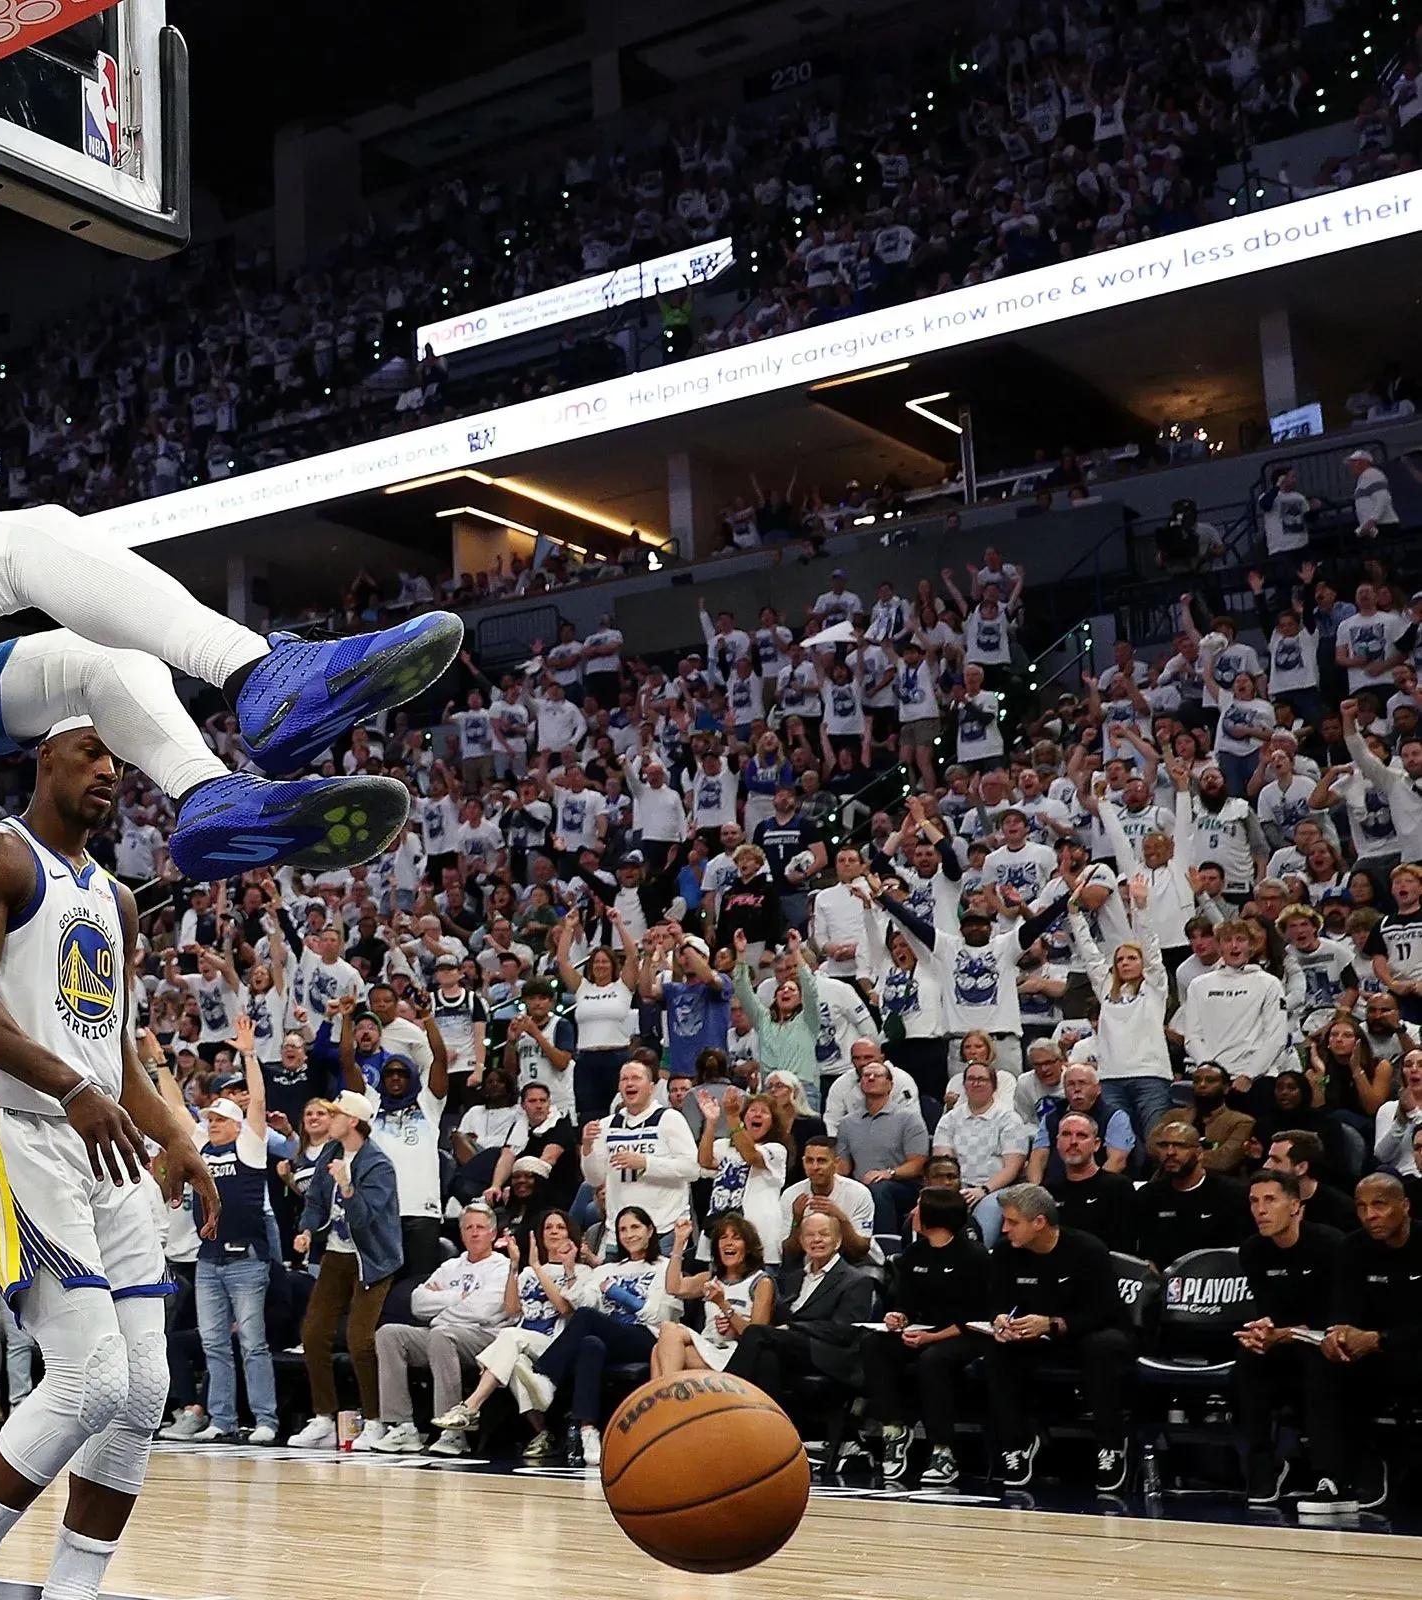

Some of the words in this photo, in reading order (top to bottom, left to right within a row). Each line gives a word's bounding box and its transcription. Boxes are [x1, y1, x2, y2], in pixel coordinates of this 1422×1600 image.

[771, 60, 812, 92] 230
[88, 135, 107, 160] NBA
[629, 371, 709, 407] Helping
[716, 354, 784, 383] family
[791, 323, 915, 366] caregivers
[923, 304, 988, 331] know
[997, 285, 1061, 314] more
[1070, 276, 1087, 295] &
[1097, 257, 1173, 288] worry
[1183, 242, 1234, 267] less
[1244, 216, 1333, 252] about
[1344, 194, 1412, 227] their
[215, 492, 245, 511] less
[250, 477, 300, 502] about
[306, 465, 346, 487] their
[351, 452, 399, 477] loved
[405, 441, 449, 463] ones
[777, 844, 783, 860] 1
[59, 907, 90, 930] GOLDEN
[96, 948, 111, 978] 10
[54, 995, 119, 1041] WARRIORS
[529, 1062, 538, 1079] 5
[404, 1126, 419, 1147] 5
[210, 1164, 236, 1179] ESOTA
[1190, 1303, 1221, 1315] Google
